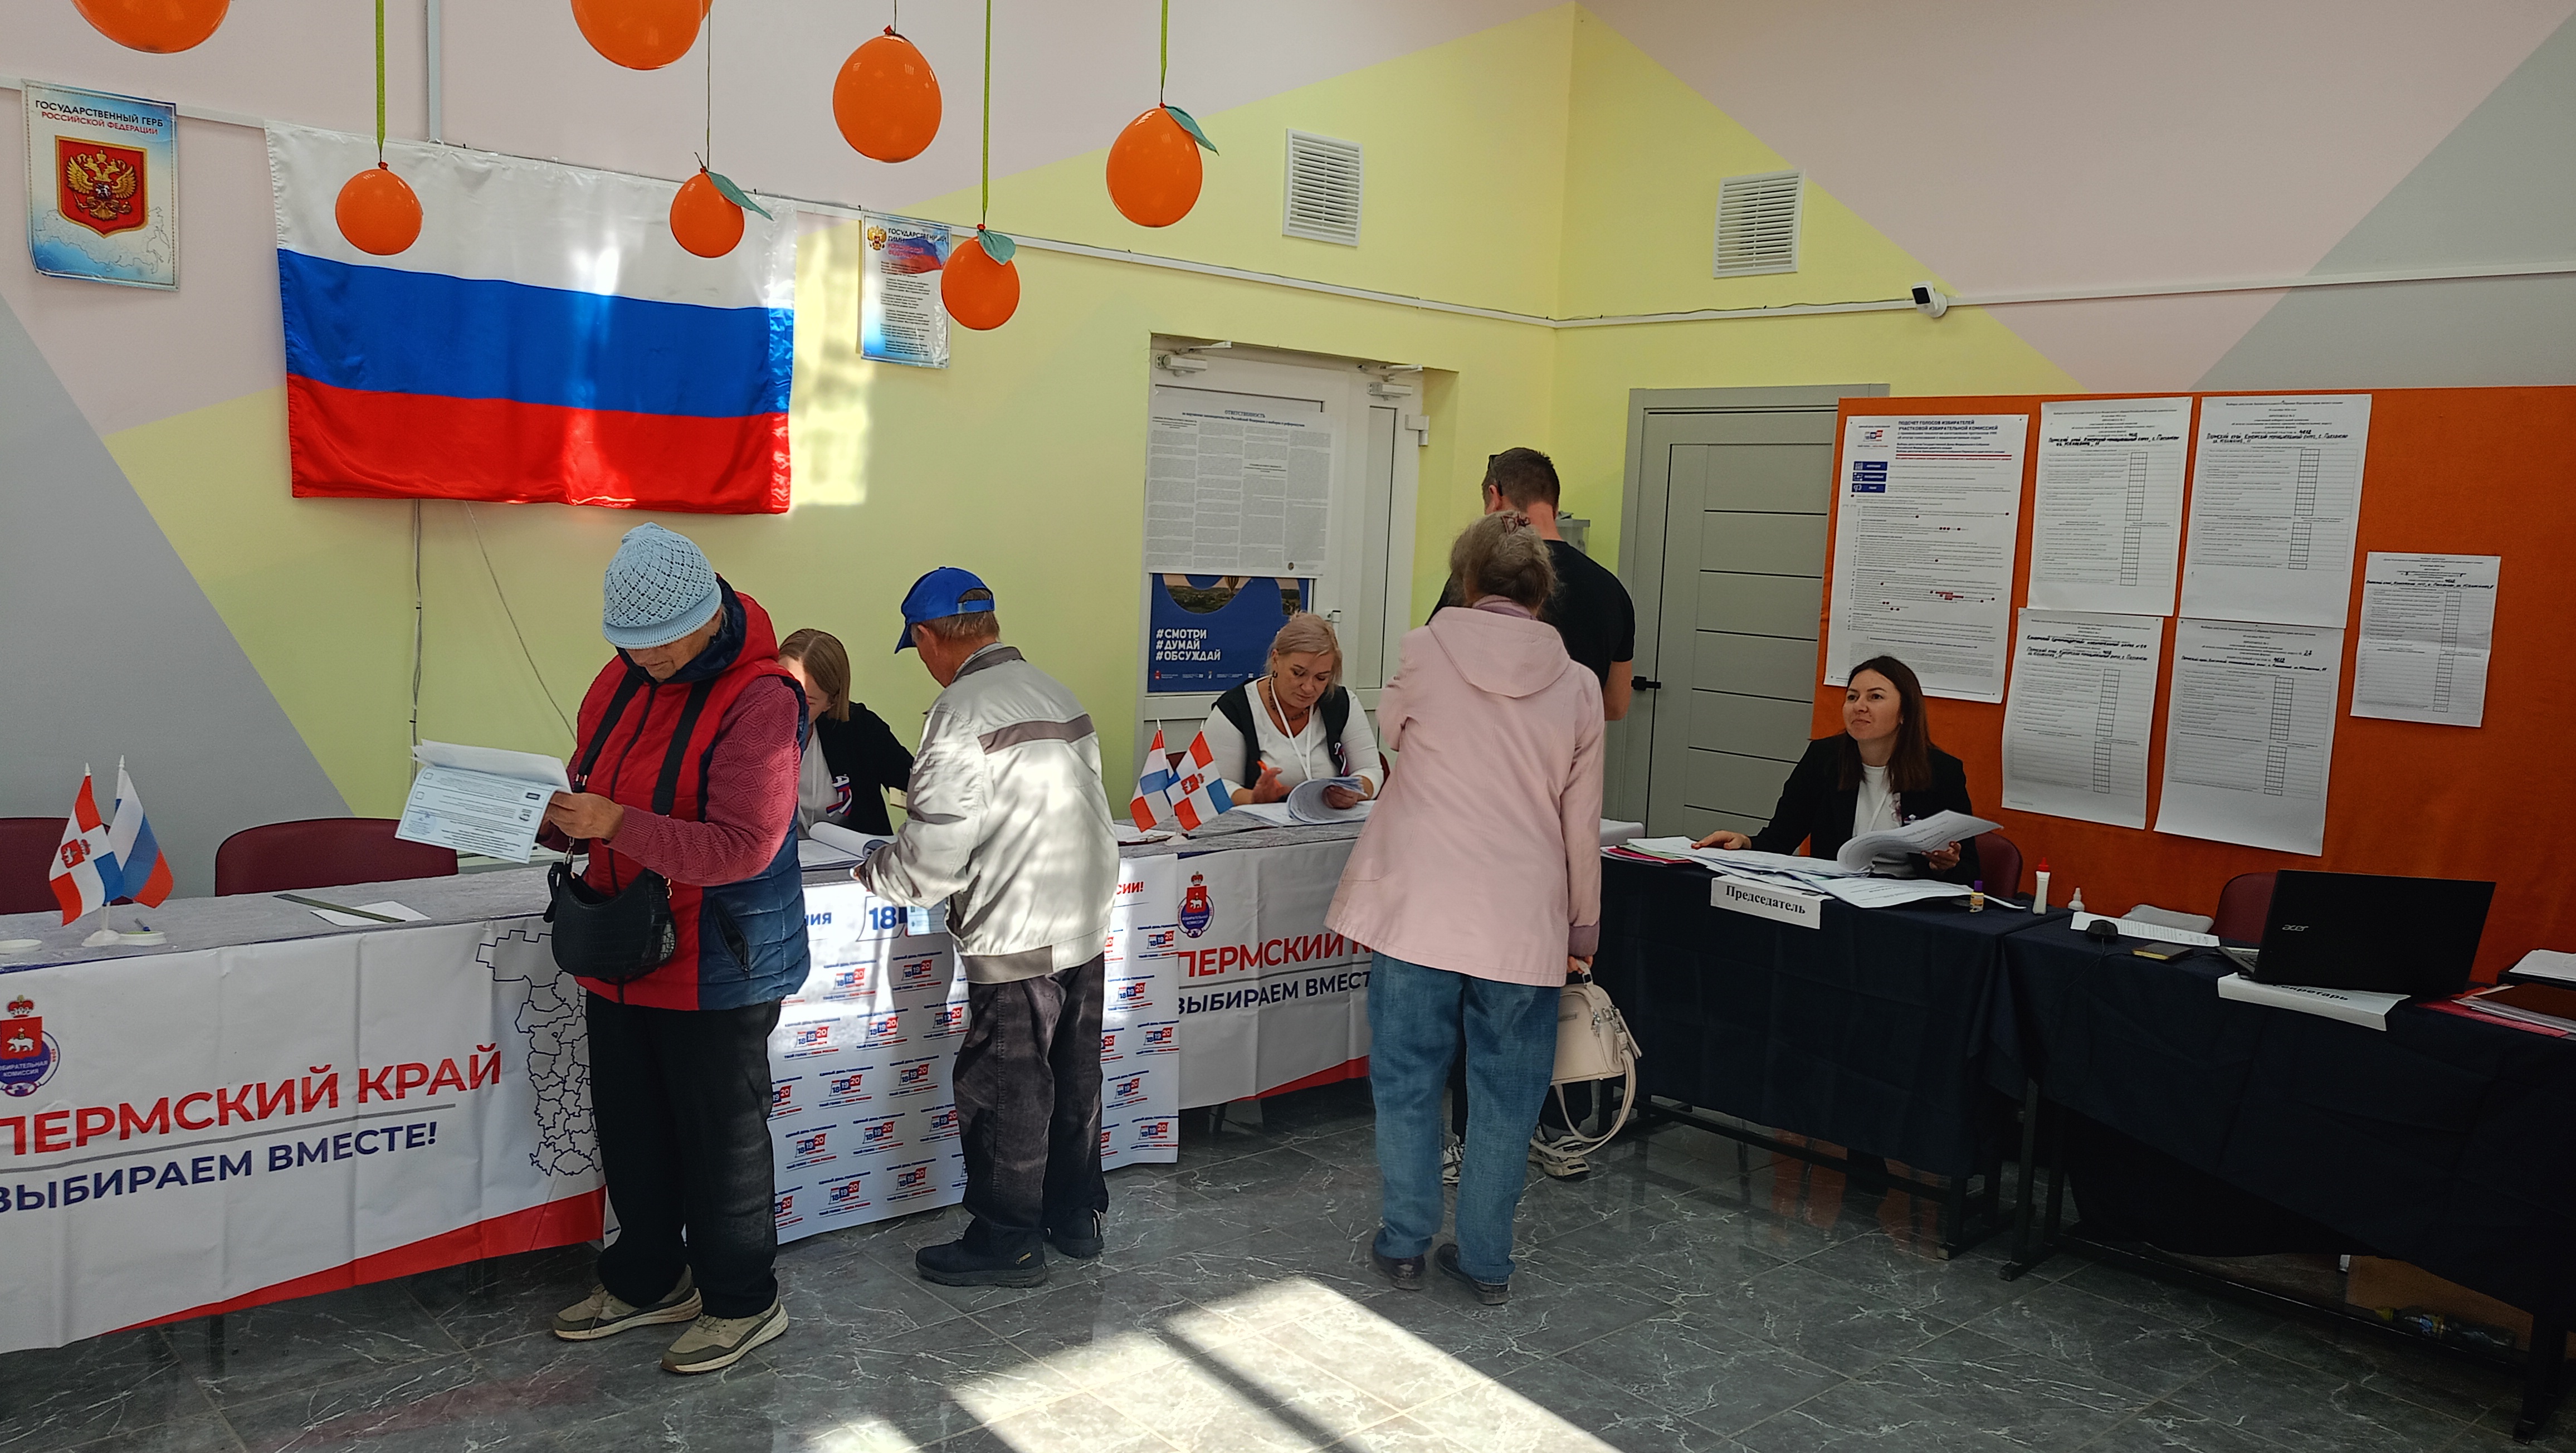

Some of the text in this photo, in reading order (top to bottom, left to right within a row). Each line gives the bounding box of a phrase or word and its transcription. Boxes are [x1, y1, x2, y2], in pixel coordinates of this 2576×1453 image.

[35, 100, 163, 128] ГОСУДАРСТВЕННЫЙ ГЕРБ
[41, 111, 158, 135] РОССИЙСКОЙ ФЕДЕРАЦИИ
[1156, 629, 1207, 640] #СМОТРИ
[1156, 638, 1200, 650] #ДУМАЙ
[1156, 649, 1221, 661] #ОБСУЖДАЙ
[1116, 881, 1144, 895] СИИ!
[1726, 885, 1806, 914] Председатель
[869, 906, 897, 930] 18
[1305, 971, 1371, 997] ВМЕСТ
[3, 1069, 39, 1077] КОМИССИЯ
[0, 1043, 501, 1155] ПЕРМСКИЙ КРАЙ
[780, 1088, 789, 1096] 20
[269, 1122, 437, 1172] ВМЕСТЕ!
[782, 1199, 791, 1207] 20
